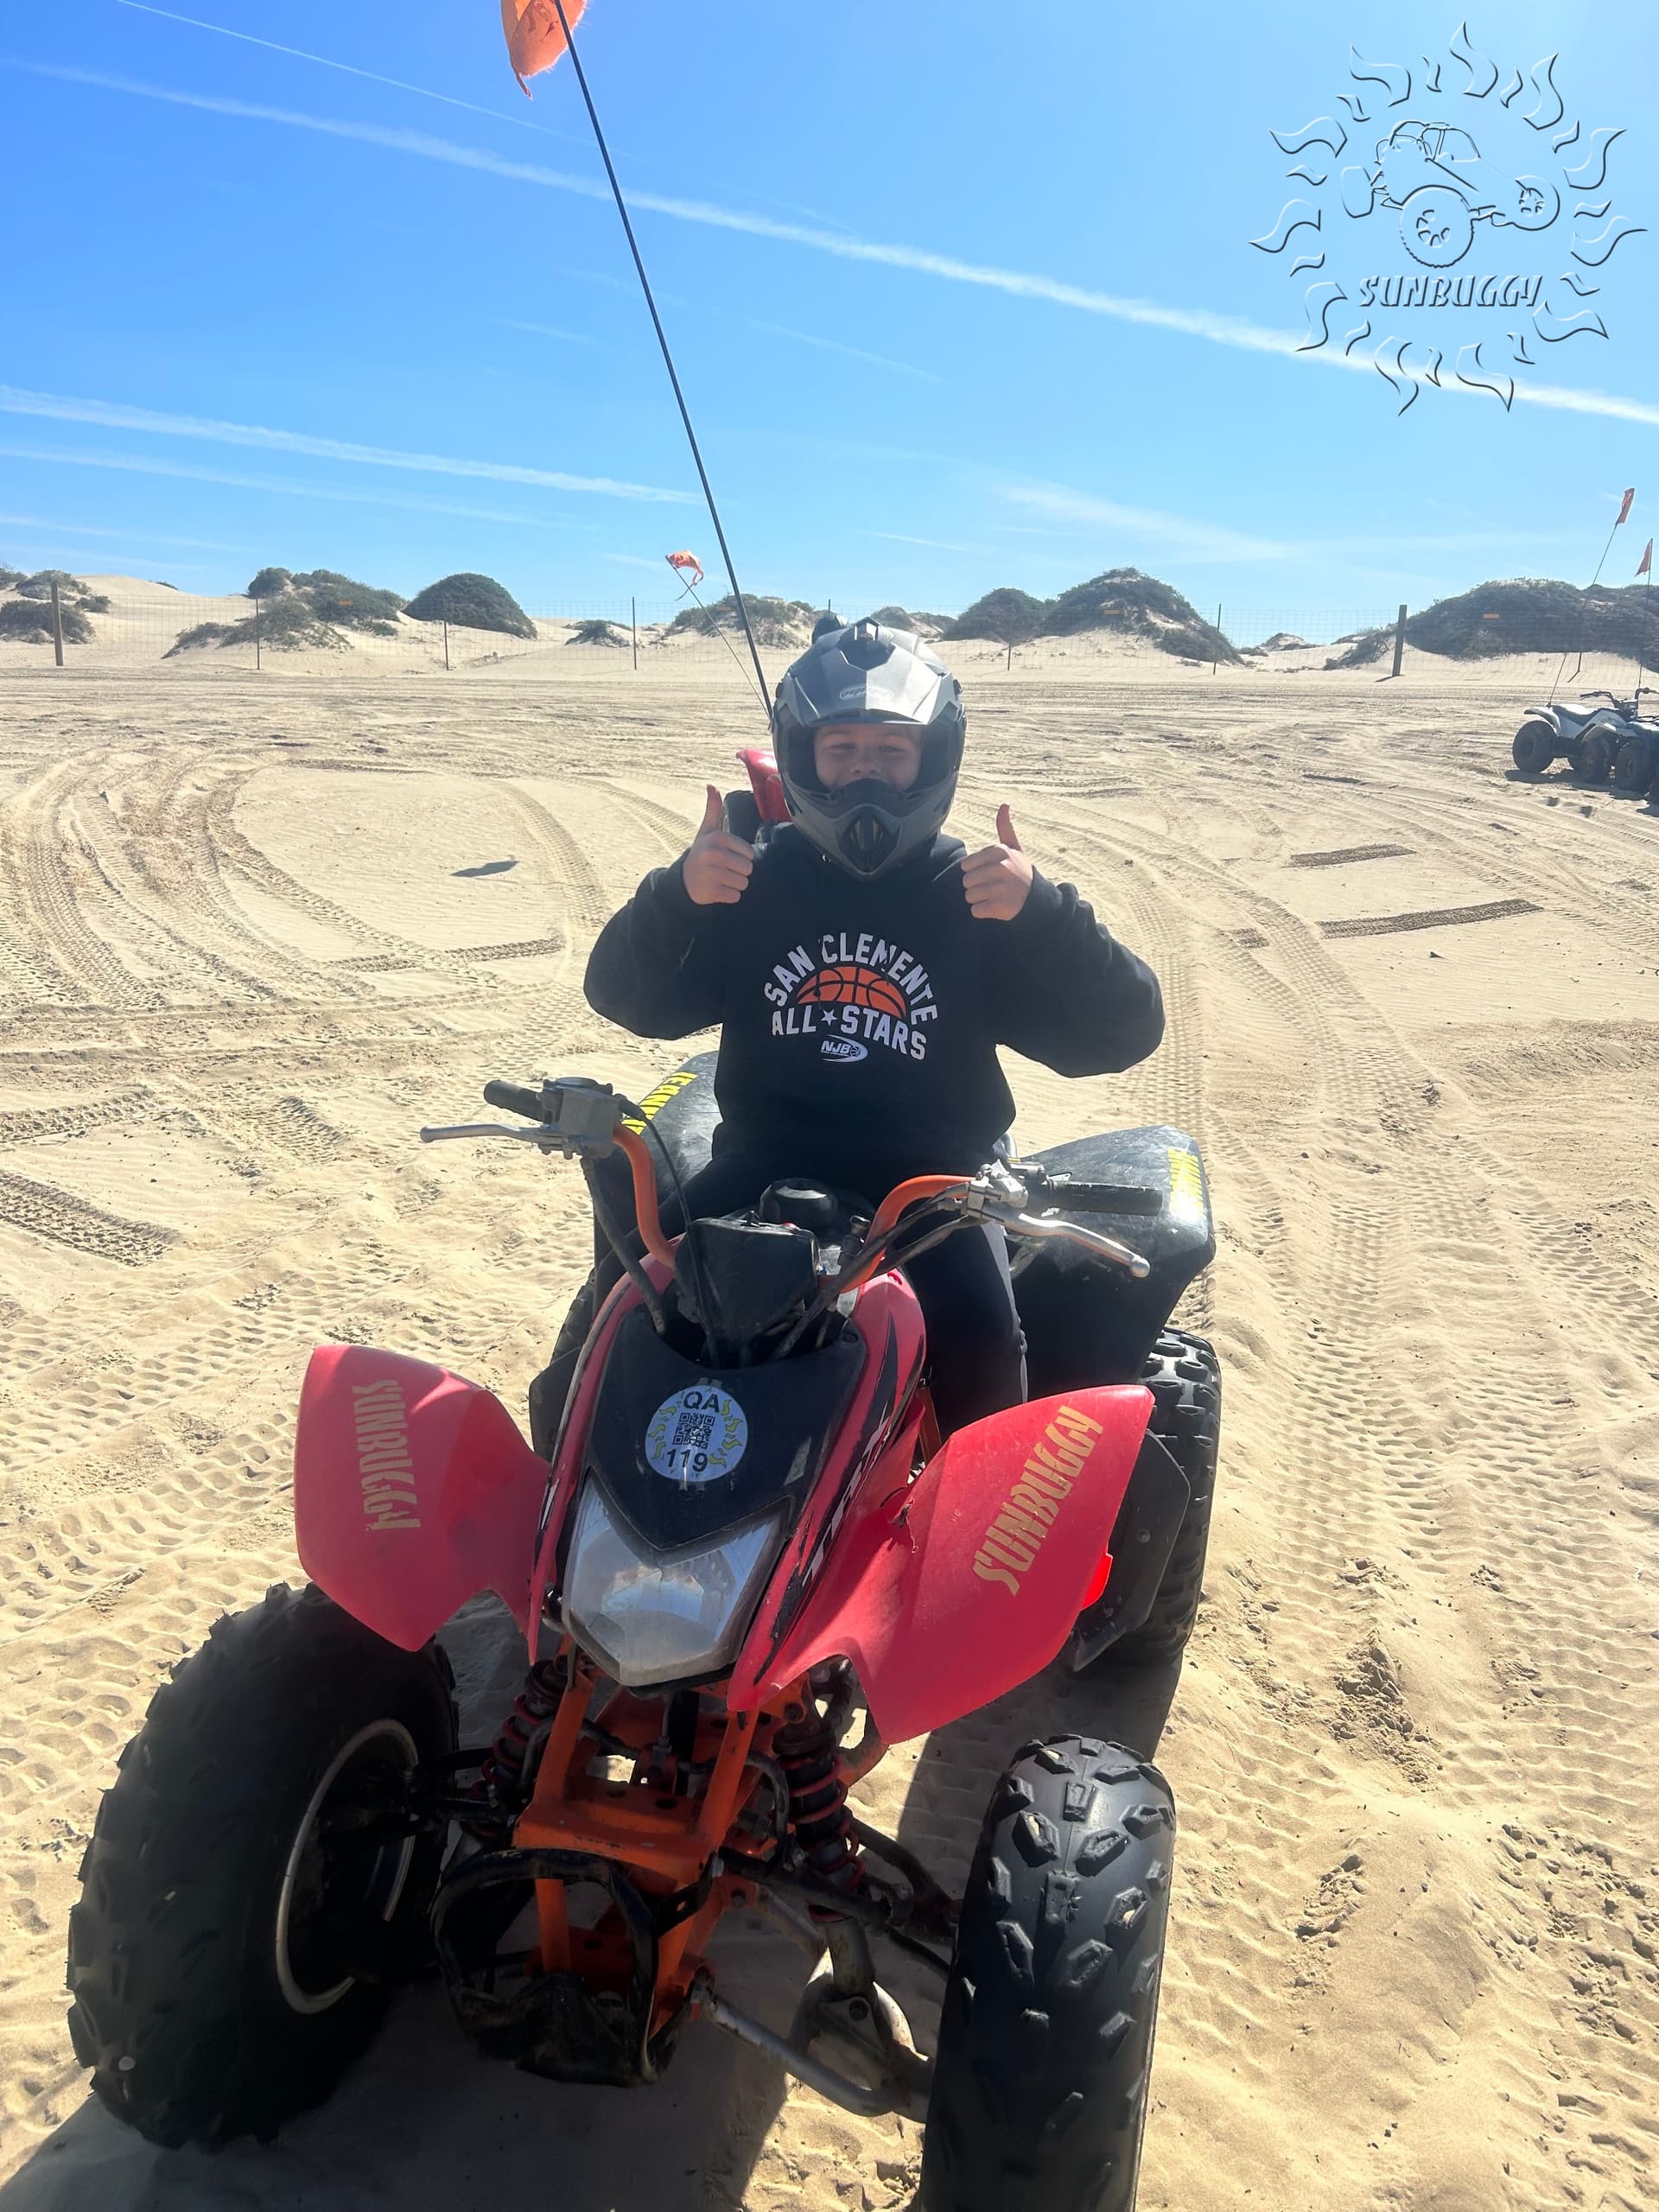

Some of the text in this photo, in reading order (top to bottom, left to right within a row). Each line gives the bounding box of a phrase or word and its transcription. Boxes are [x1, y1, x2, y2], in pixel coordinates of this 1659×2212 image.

[764, 932, 938, 1026] SAN CLEMENTE
[772, 1005, 927, 1061] ALL STARS
[821, 1040, 851, 1055] NJB
[683, 1390, 721, 1414] QA
[352, 1379, 422, 1533] SUNBUGGY
[666, 1448, 709, 1472] 119
[973, 1405, 1104, 1598] SUNBUGGY
